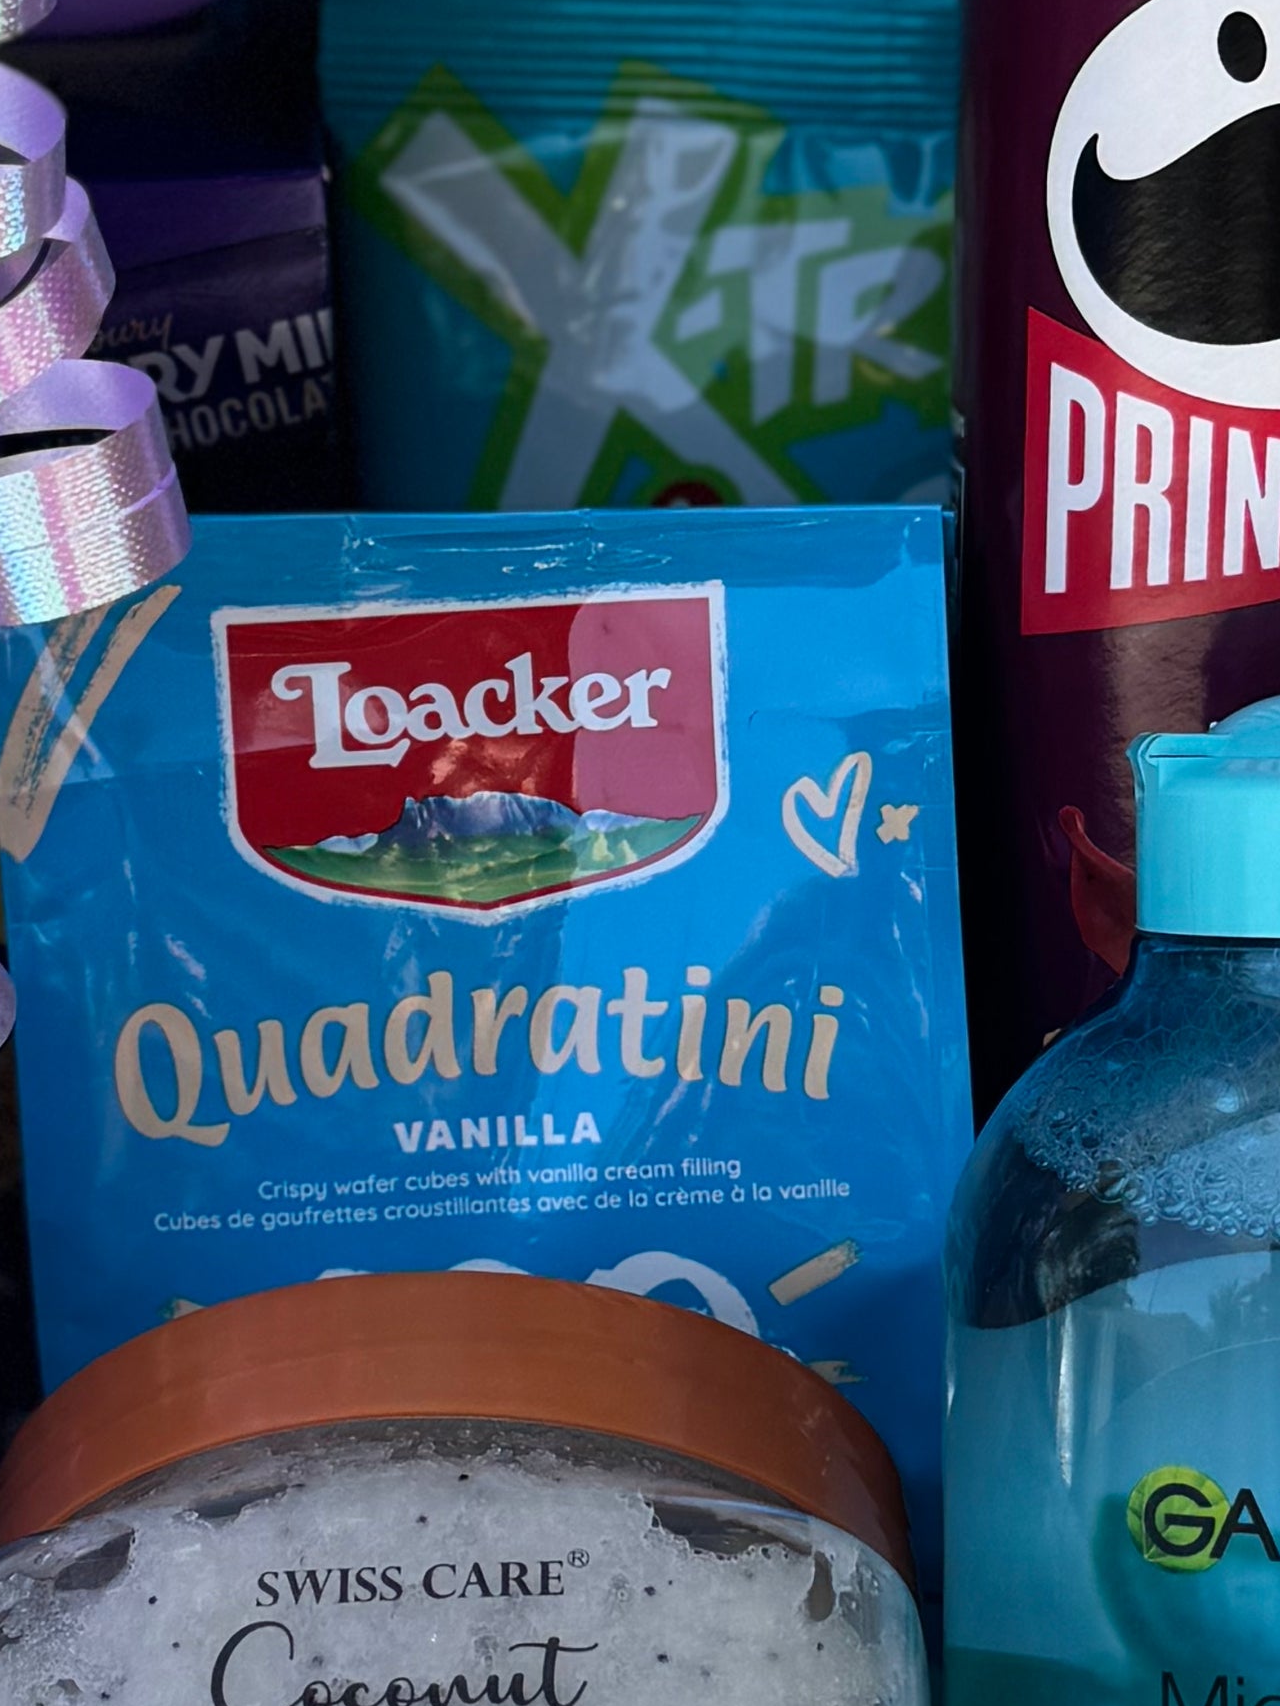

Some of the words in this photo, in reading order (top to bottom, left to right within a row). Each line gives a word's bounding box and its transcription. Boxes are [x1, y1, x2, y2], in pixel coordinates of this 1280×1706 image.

[164, 372, 334, 452] HOCOLA
[271, 652, 672, 769] Loacker
[115, 965, 845, 1148] Quadratini
[392, 1110, 603, 1154] VANILLA
[154, 1211, 221, 1232] Cubes
[227, 1209, 255, 1229] de
[261, 1204, 378, 1231] gaufrettes
[383, 1194, 531, 1221] croustillantes
[536, 1193, 589, 1212] avec
[594, 1190, 621, 1210] de
[628, 1189, 649, 1208] la
[654, 1184, 724, 1207] crème
[730, 1184, 745, 1204] à
[752, 1182, 773, 1202] la
[778, 1178, 851, 1200] vanille
[257, 1179, 328, 1202] Crispy
[334, 1173, 399, 1196] wafer
[404, 1169, 470, 1191] cubes
[476, 1166, 522, 1186] with
[527, 1162, 599, 1184] vanilla
[604, 1160, 675, 1181] cream
[680, 1157, 742, 1179] filling
[254, 1565, 405, 1609] SWISS
